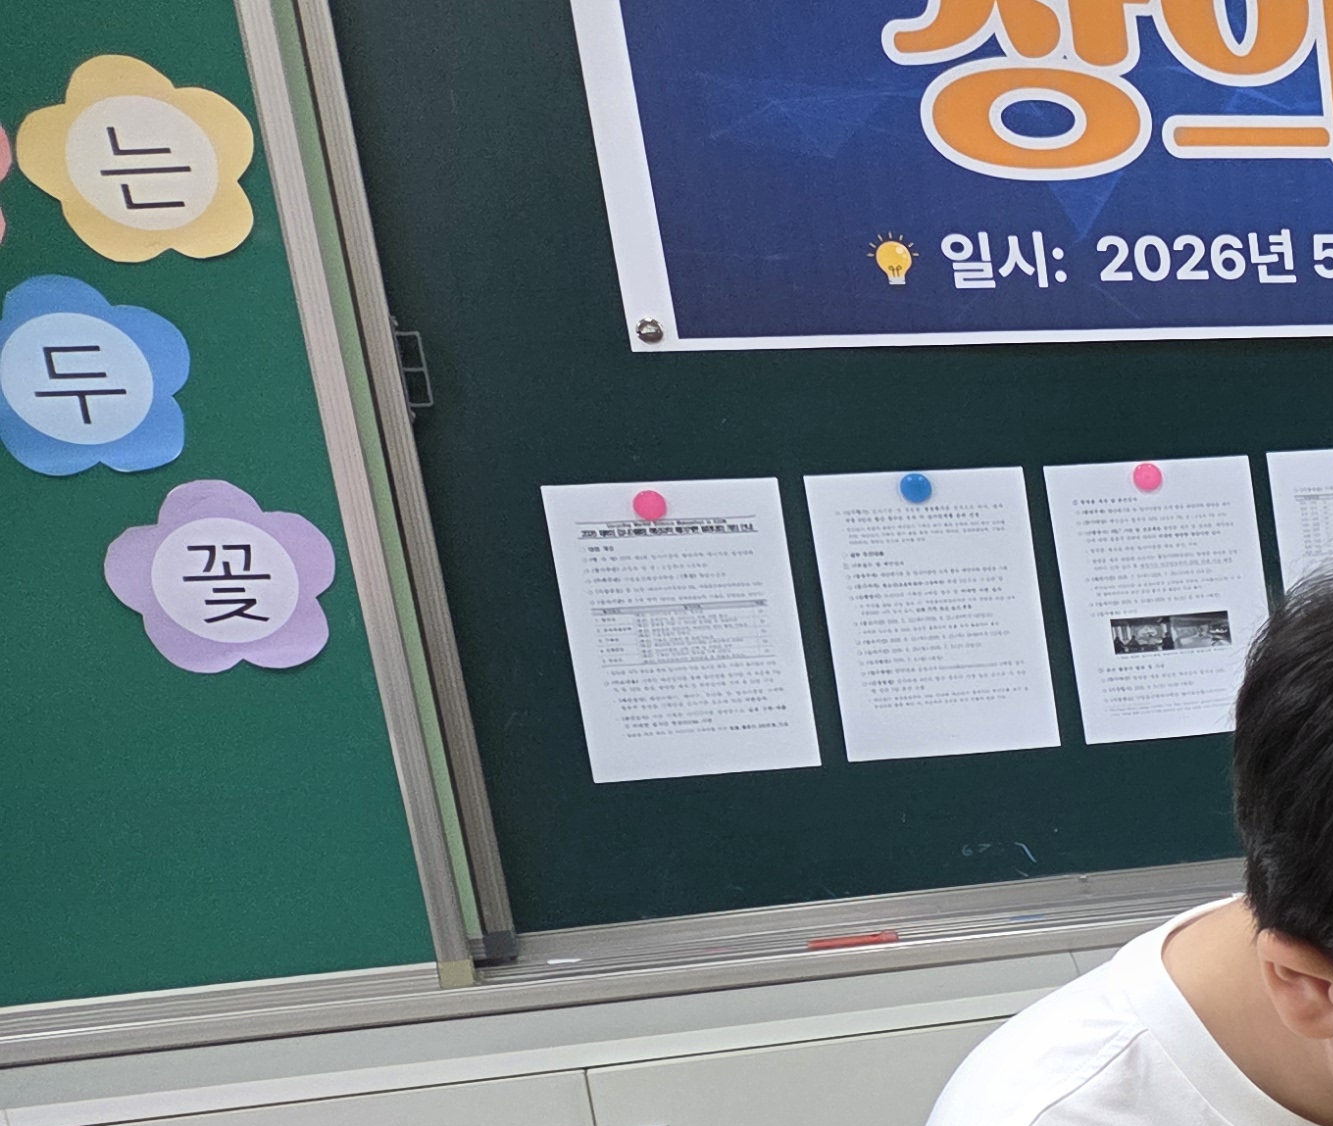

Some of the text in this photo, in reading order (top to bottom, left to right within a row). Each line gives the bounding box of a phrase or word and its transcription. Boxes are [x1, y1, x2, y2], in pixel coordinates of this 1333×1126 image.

[100, 126, 192, 210] 는
[941, 231, 1067, 289] 일시:
[1096, 228, 1297, 284] 2026년
[33, 345, 127, 425] 두
[182, 544, 271, 624] 꽃
